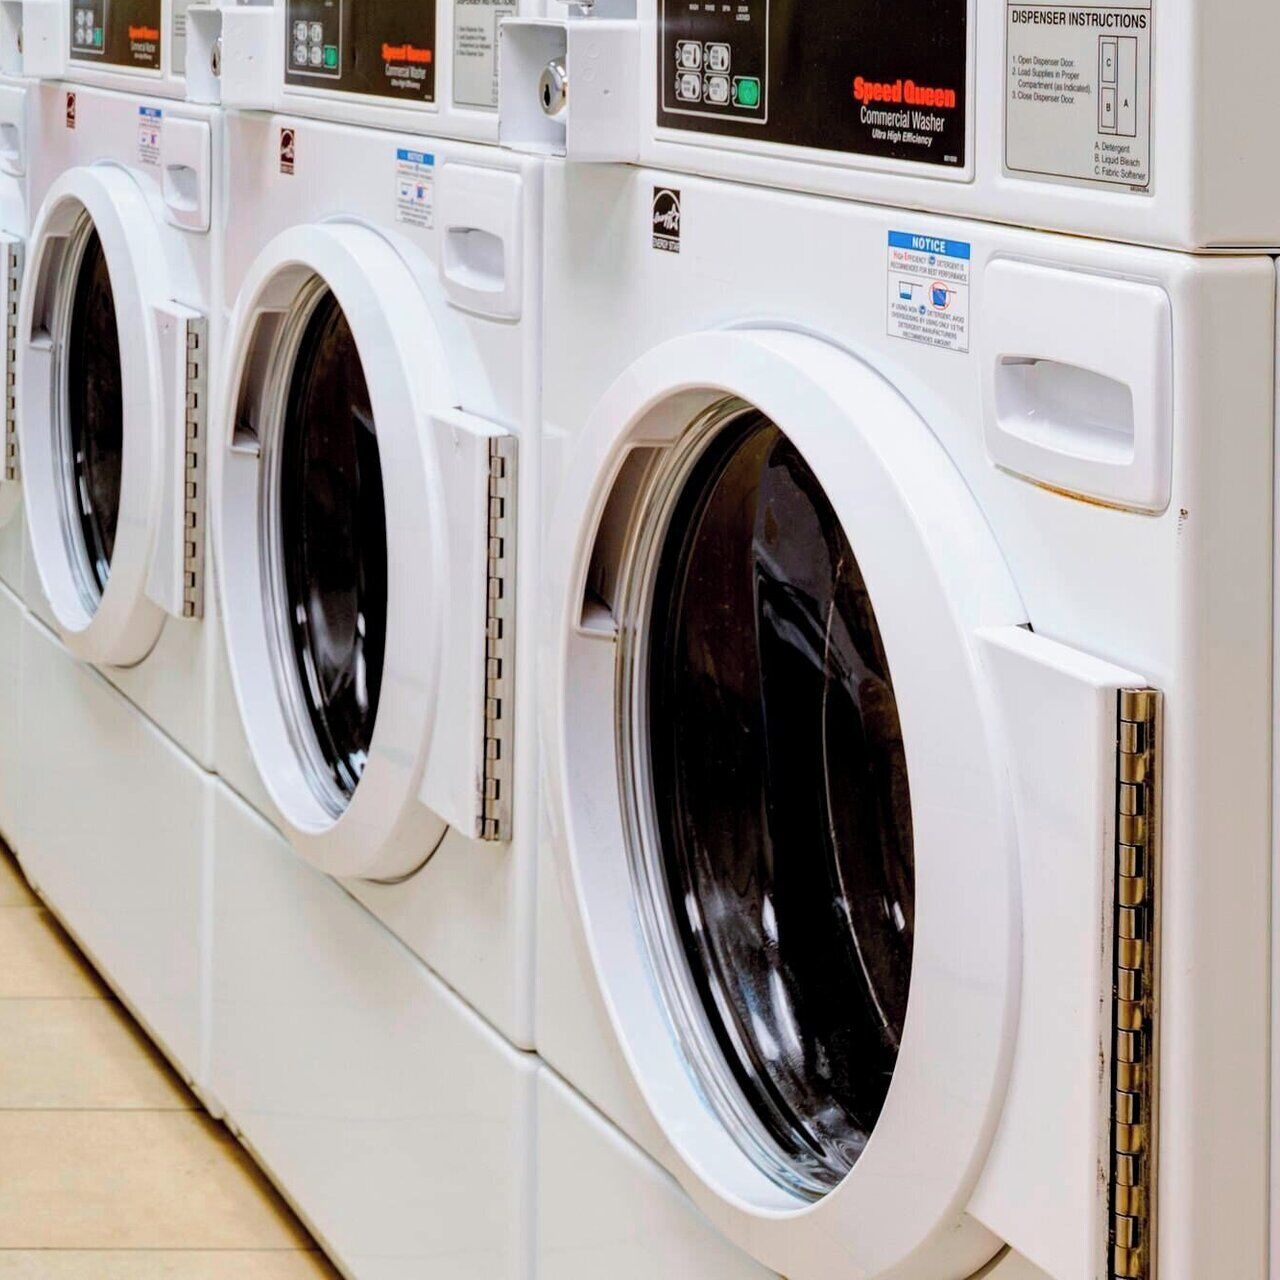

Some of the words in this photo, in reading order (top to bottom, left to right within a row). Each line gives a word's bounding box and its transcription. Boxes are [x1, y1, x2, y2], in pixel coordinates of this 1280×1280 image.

[1012, 10, 1066, 25] DISPENSER
[1069, 13, 1147, 29] INSTRUCTIONS
[1018, 55, 1032, 66] Open
[1033, 56, 1060, 67] Dispenser
[1106, 58, 1111, 67] C
[1018, 68, 1031, 77] Load
[1032, 70, 1054, 80] Supplies
[1061, 71, 1080, 81] Proper
[854, 76, 902, 105] Speed
[904, 80, 955, 108] Queen
[1018, 79, 1053, 92] Compartment
[1018, 91, 1033, 101] Close
[1034, 92, 1060, 104] Dispenser
[1123, 98, 1129, 108] A
[1106, 102, 1111, 112] B
[860, 105, 910, 128] Commercial
[912, 111, 945, 132] Washer
[872, 128, 886, 140] Ultra
[887, 130, 901, 144] High
[902, 131, 933, 147] Efficiency
[1101, 142, 1130, 154] Detergent
[1101, 154, 1119, 166] Liquid
[1120, 157, 1140, 167] Bleach
[1101, 165, 1120, 178] Fabric
[1121, 169, 1146, 180] Softener
[912, 236, 946, 253] NOTICE
